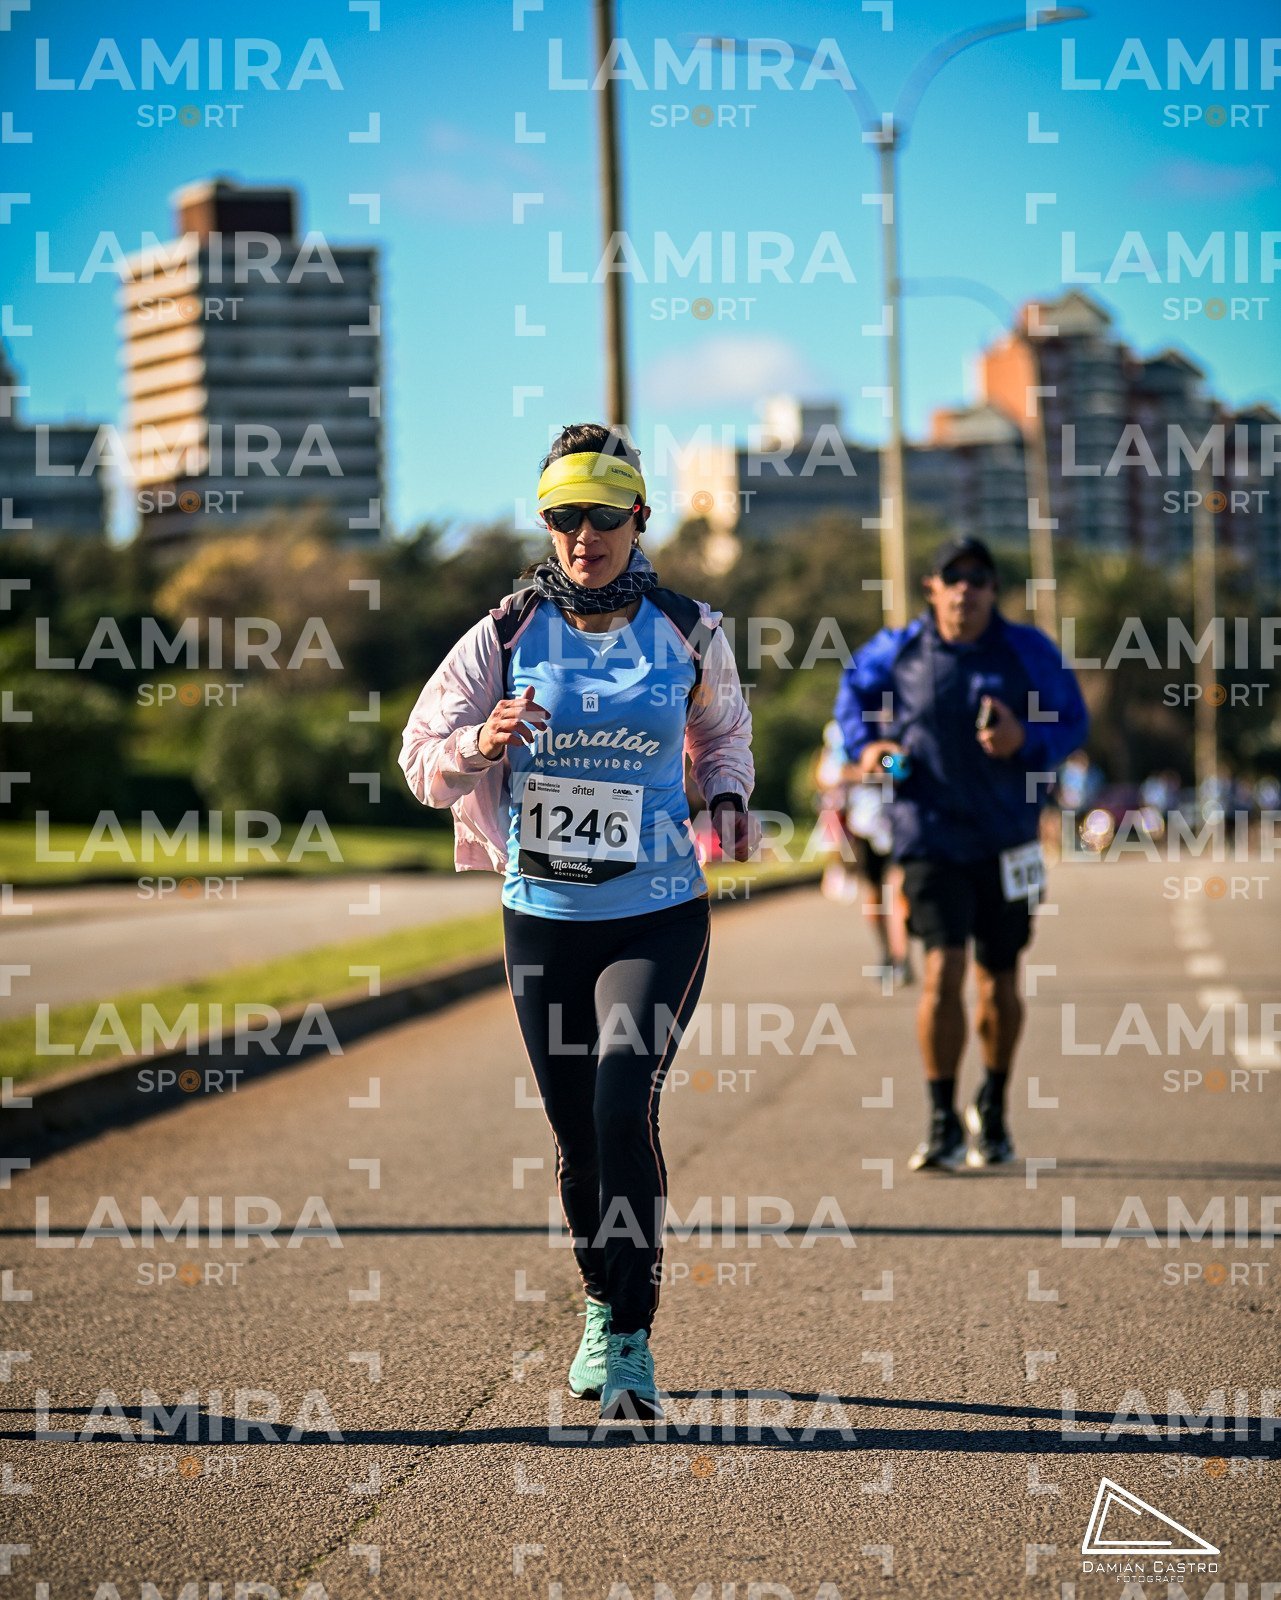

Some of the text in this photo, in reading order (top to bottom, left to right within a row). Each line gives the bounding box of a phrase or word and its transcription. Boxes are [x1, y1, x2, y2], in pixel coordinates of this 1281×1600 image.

[532, 727, 660, 756] Maratón
[535, 757, 643, 770] MONTEVIDEO
[572, 785, 595, 796] antel
[529, 803, 629, 848] 1246
[551, 859, 593, 874] Maratón
[554, 871, 588, 879] MONTEVIDEO
